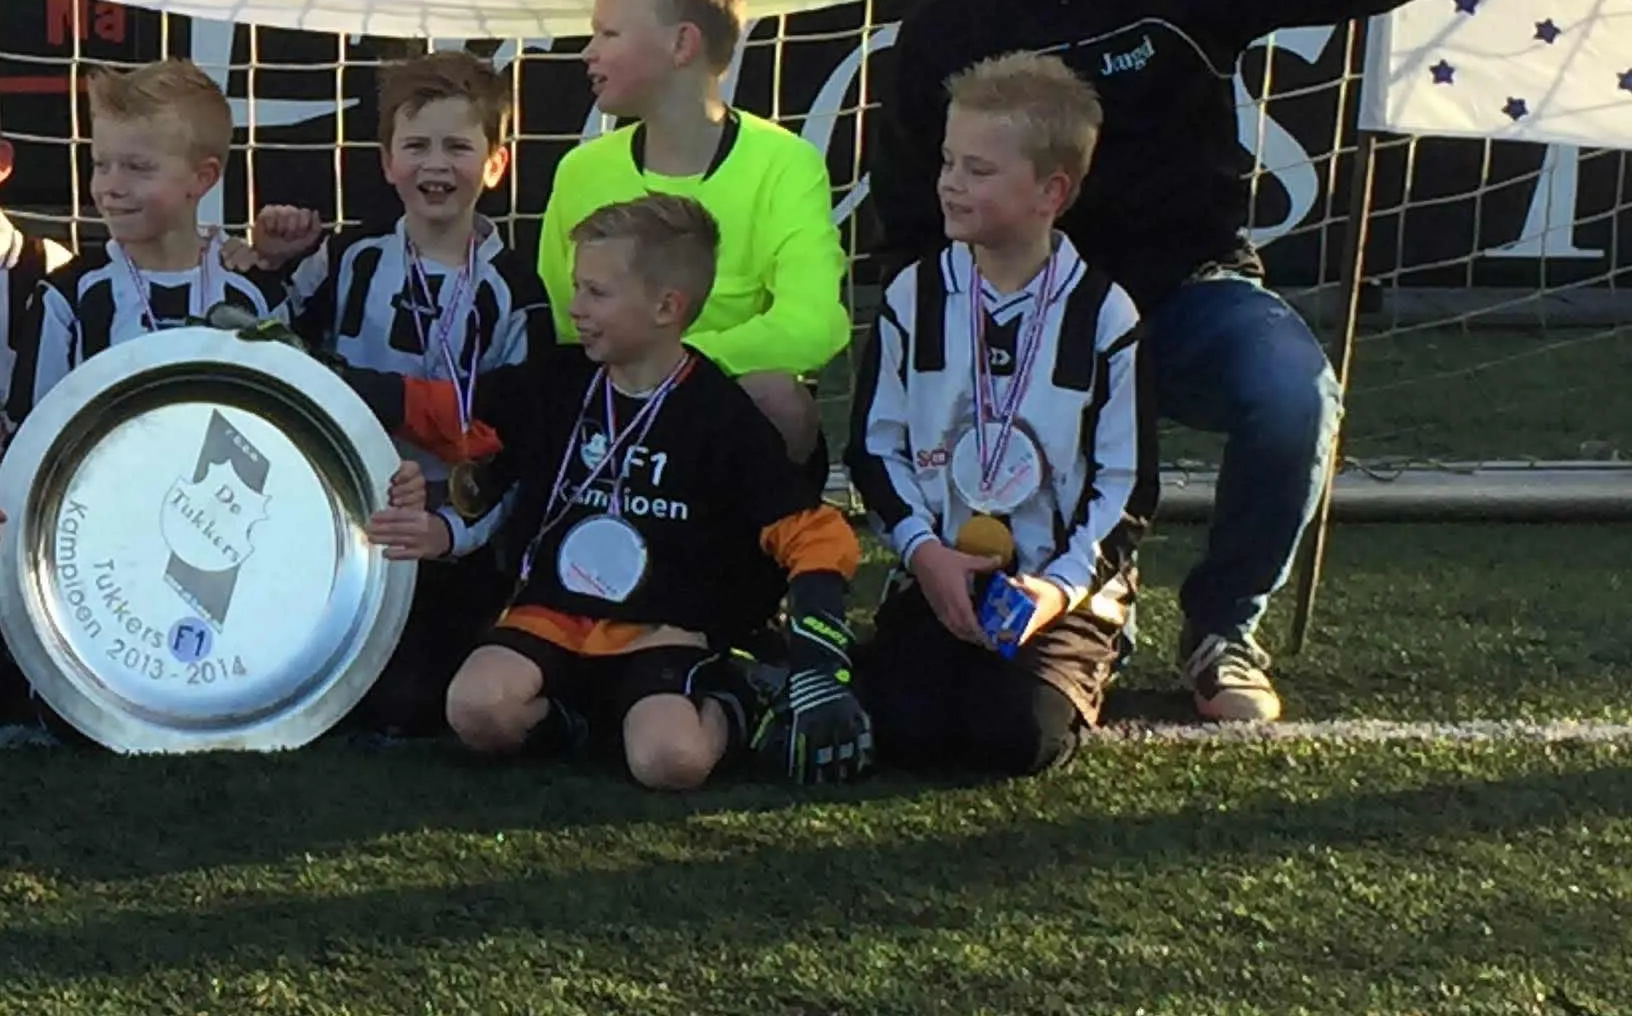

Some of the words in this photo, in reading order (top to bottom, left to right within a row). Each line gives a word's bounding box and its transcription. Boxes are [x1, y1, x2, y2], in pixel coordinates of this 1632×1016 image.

[620, 444, 668, 487] F1
[56, 499, 103, 640] Kampioen
[93, 558, 167, 650] Tukkers
[172, 624, 207, 658] F1
